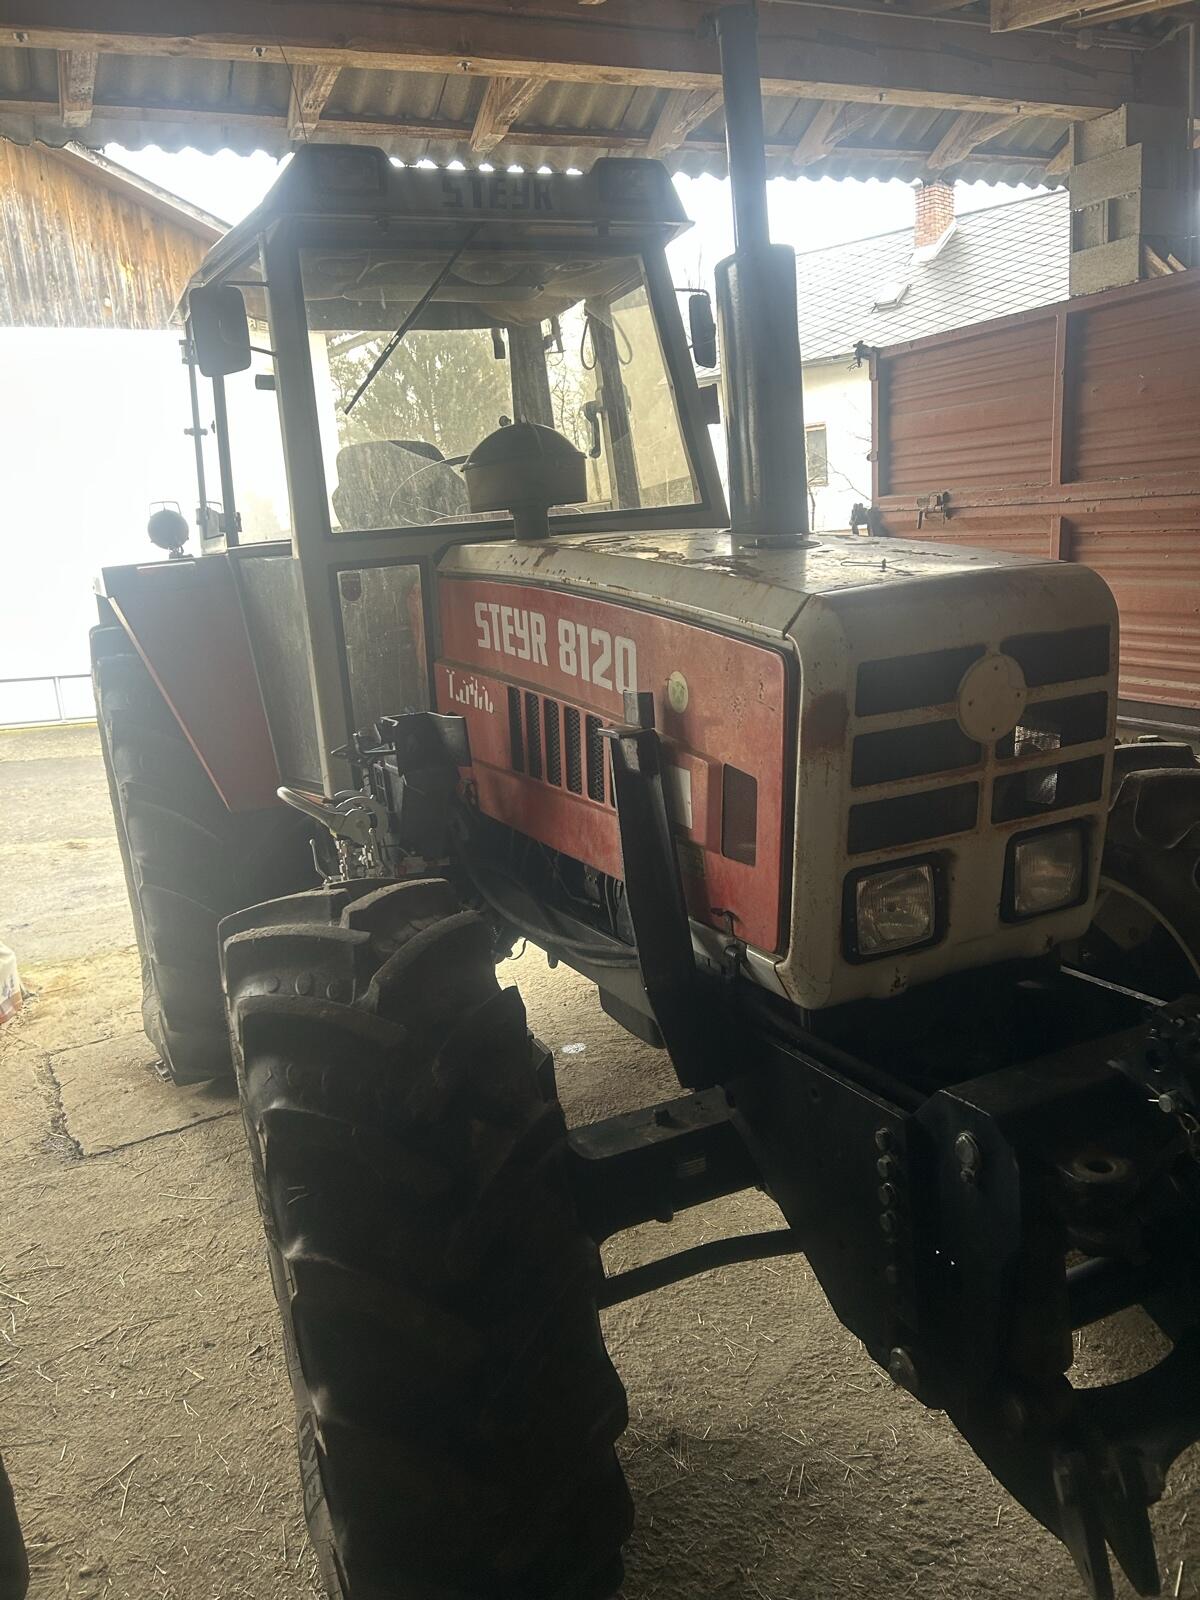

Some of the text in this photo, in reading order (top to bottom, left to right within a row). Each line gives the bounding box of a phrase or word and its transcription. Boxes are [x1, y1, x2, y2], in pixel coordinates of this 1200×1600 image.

[441, 176, 553, 210] STEYR
[474, 601, 637, 694] STEYR 8120
